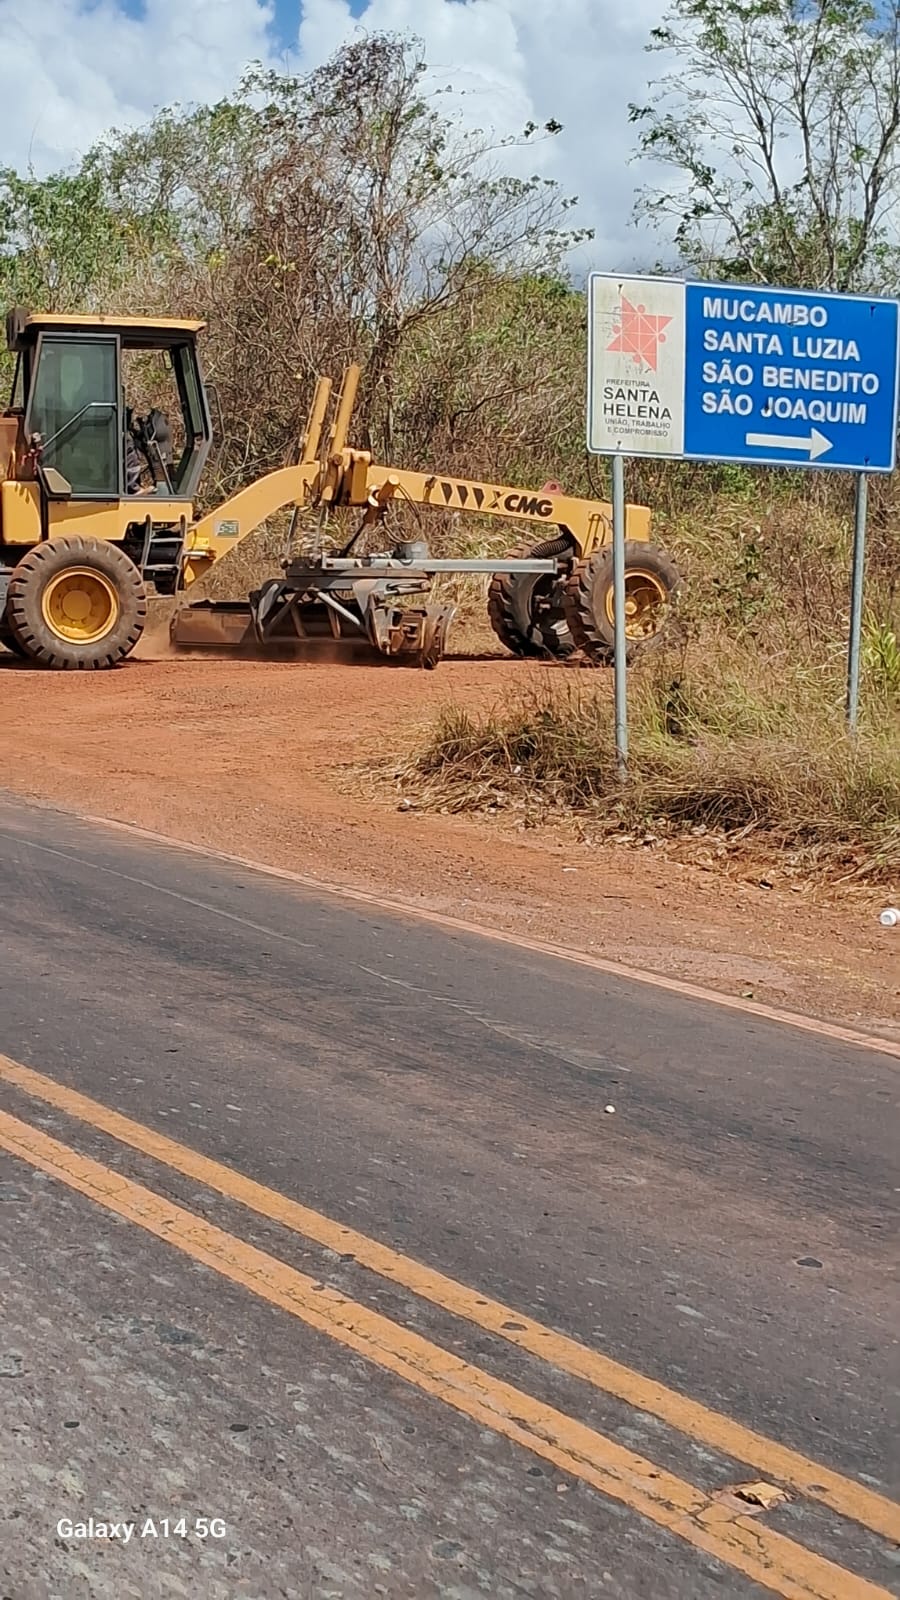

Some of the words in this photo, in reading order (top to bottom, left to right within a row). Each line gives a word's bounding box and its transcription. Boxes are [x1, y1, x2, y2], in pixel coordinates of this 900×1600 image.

[703, 297, 828, 327] MUCAMBO
[703, 329, 783, 356] SANTA
[793, 336, 860, 361] LUZIA
[606, 379, 650, 387] PREFEITURA
[702, 359, 753, 385] SÃO
[763, 366, 879, 394] BENEDITO
[603, 387, 660, 403] SANTA
[702, 389, 753, 416] SÃO
[761, 396, 867, 424] JOAQUIM
[603, 403, 672, 420] HELENA
[632, 420, 671, 429] TRABALHO
[488, 490, 553, 517] XCMG
